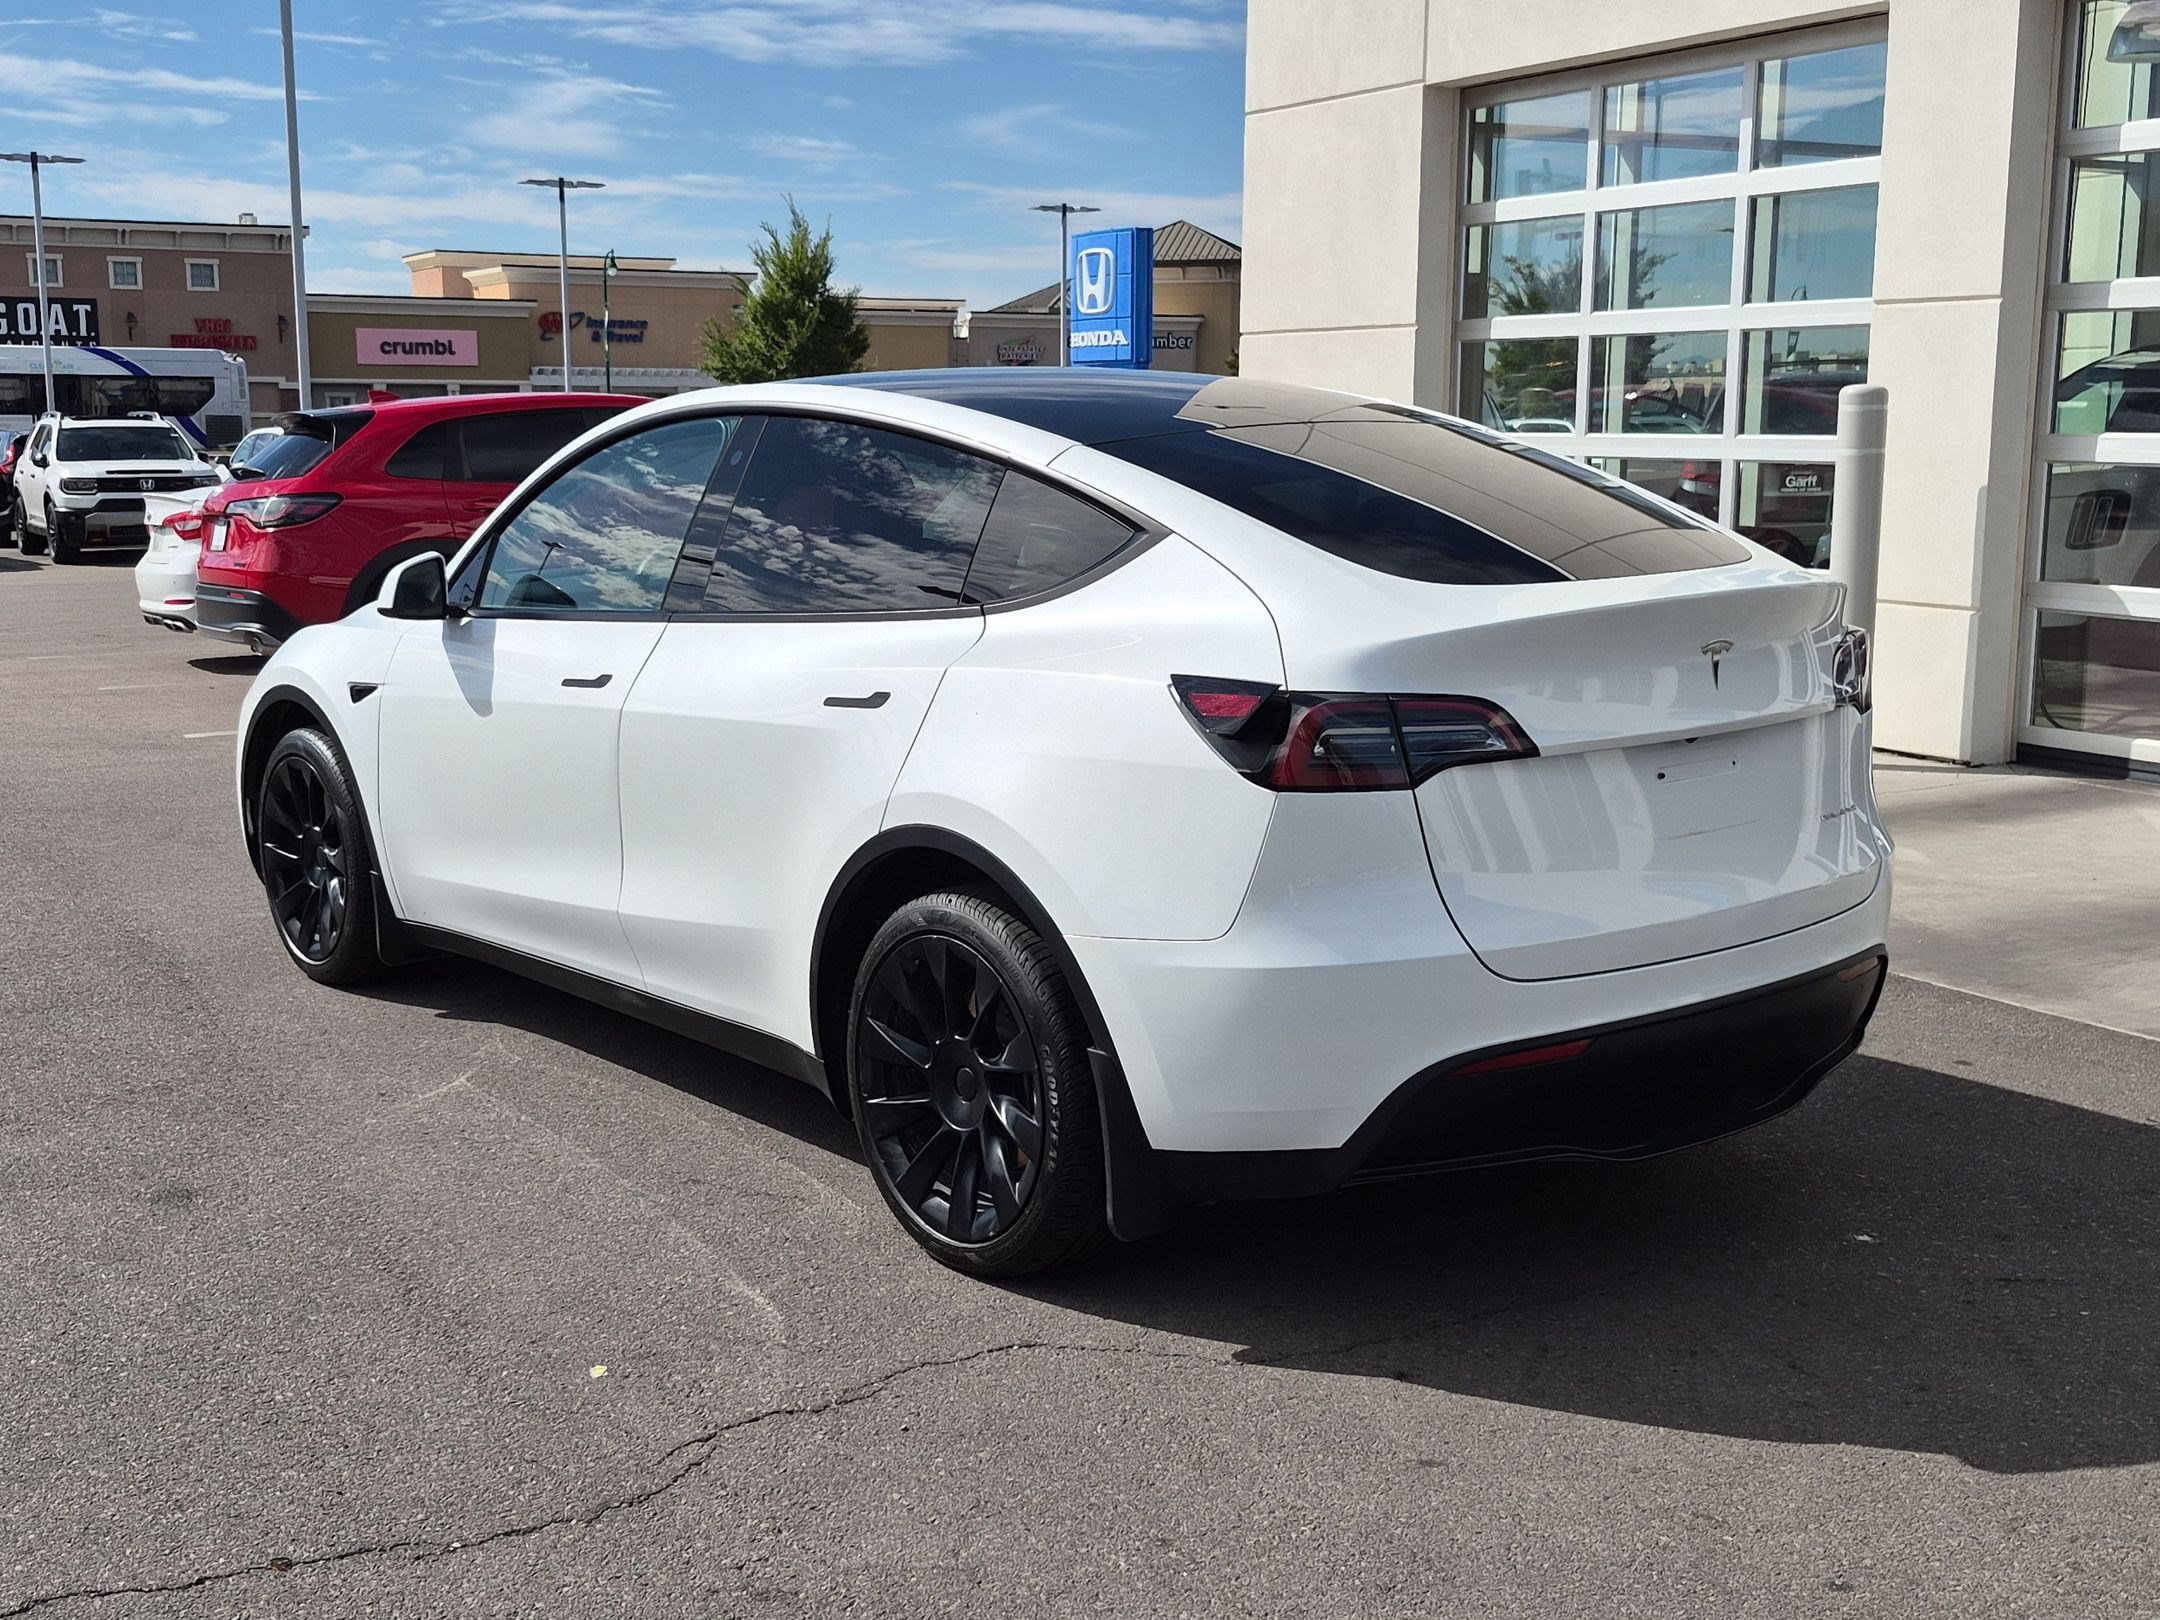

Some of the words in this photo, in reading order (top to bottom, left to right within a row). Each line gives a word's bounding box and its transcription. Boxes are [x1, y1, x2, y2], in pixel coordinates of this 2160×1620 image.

[380, 339, 456, 355] crumbl
[1070, 330, 1128, 348] HONDA
[1152, 332, 1192, 348] mber
